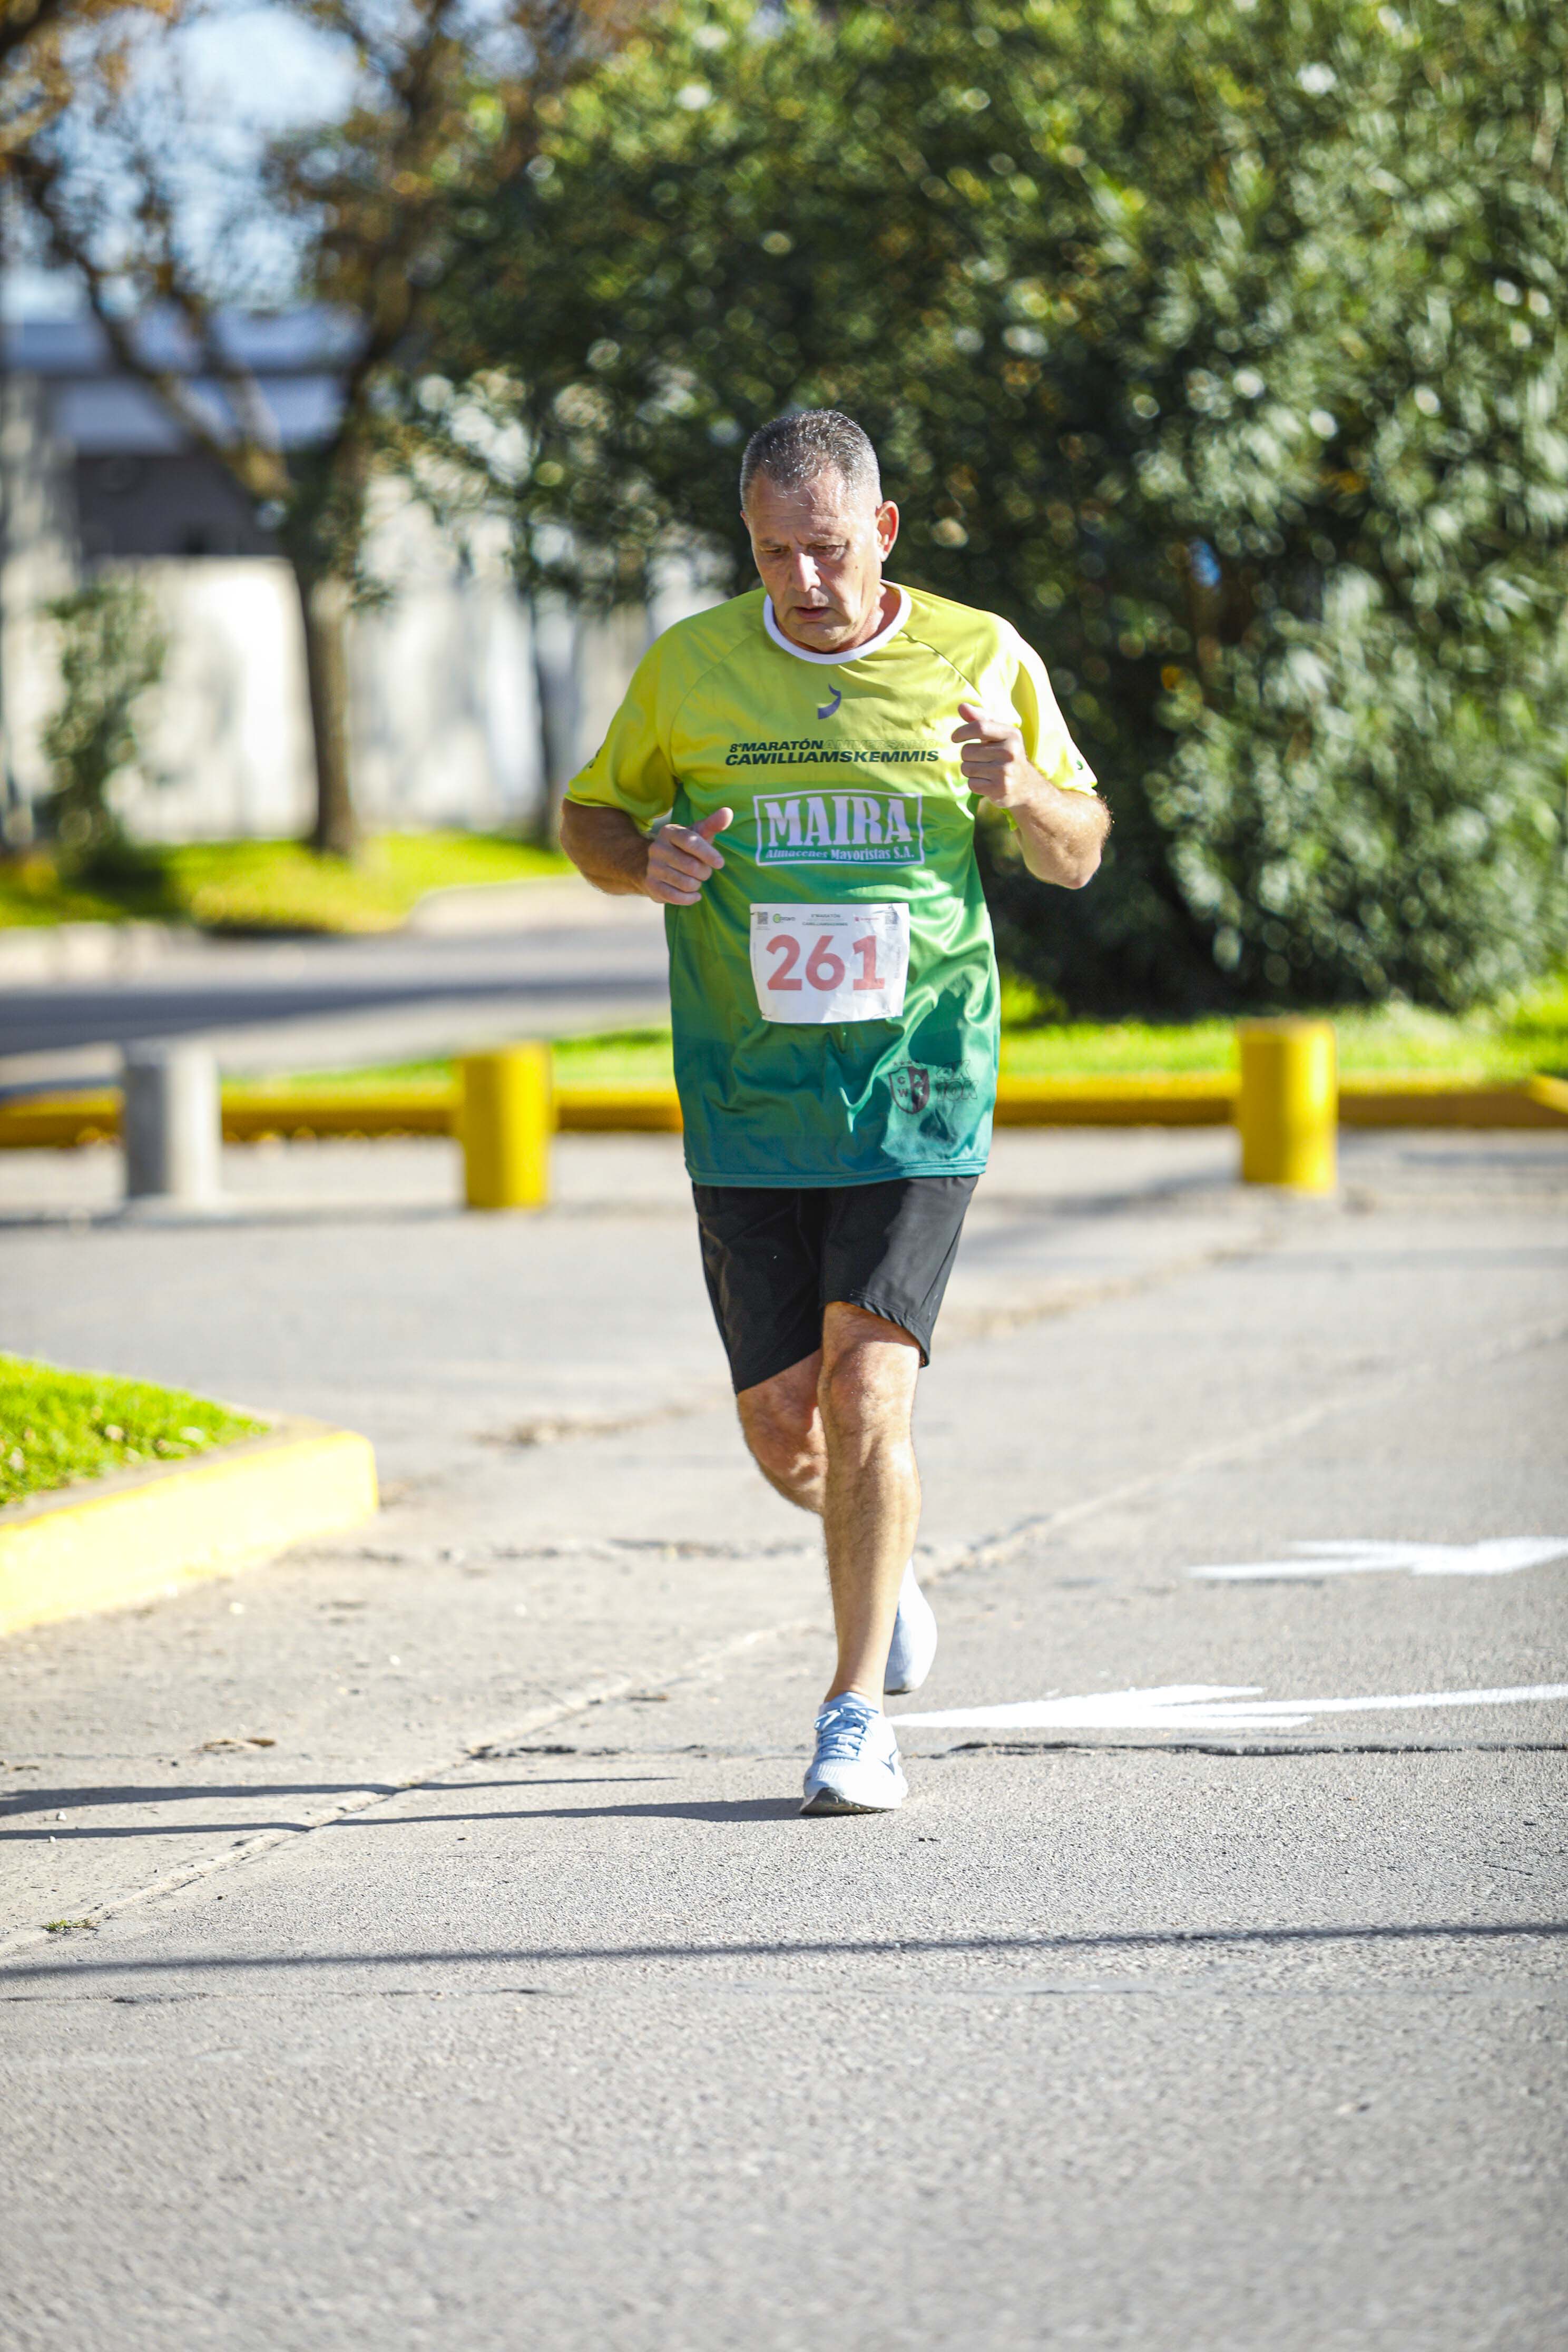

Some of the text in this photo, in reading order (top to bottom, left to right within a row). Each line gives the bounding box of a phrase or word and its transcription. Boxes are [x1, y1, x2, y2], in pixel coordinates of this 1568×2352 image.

[725, 751, 939, 766] CAWILLIAMSKEMMIS
[765, 796, 913, 846] MAIRA
[766, 846, 915, 860] Almacenes Mayoristas S.A.
[766, 934, 886, 991] 261
